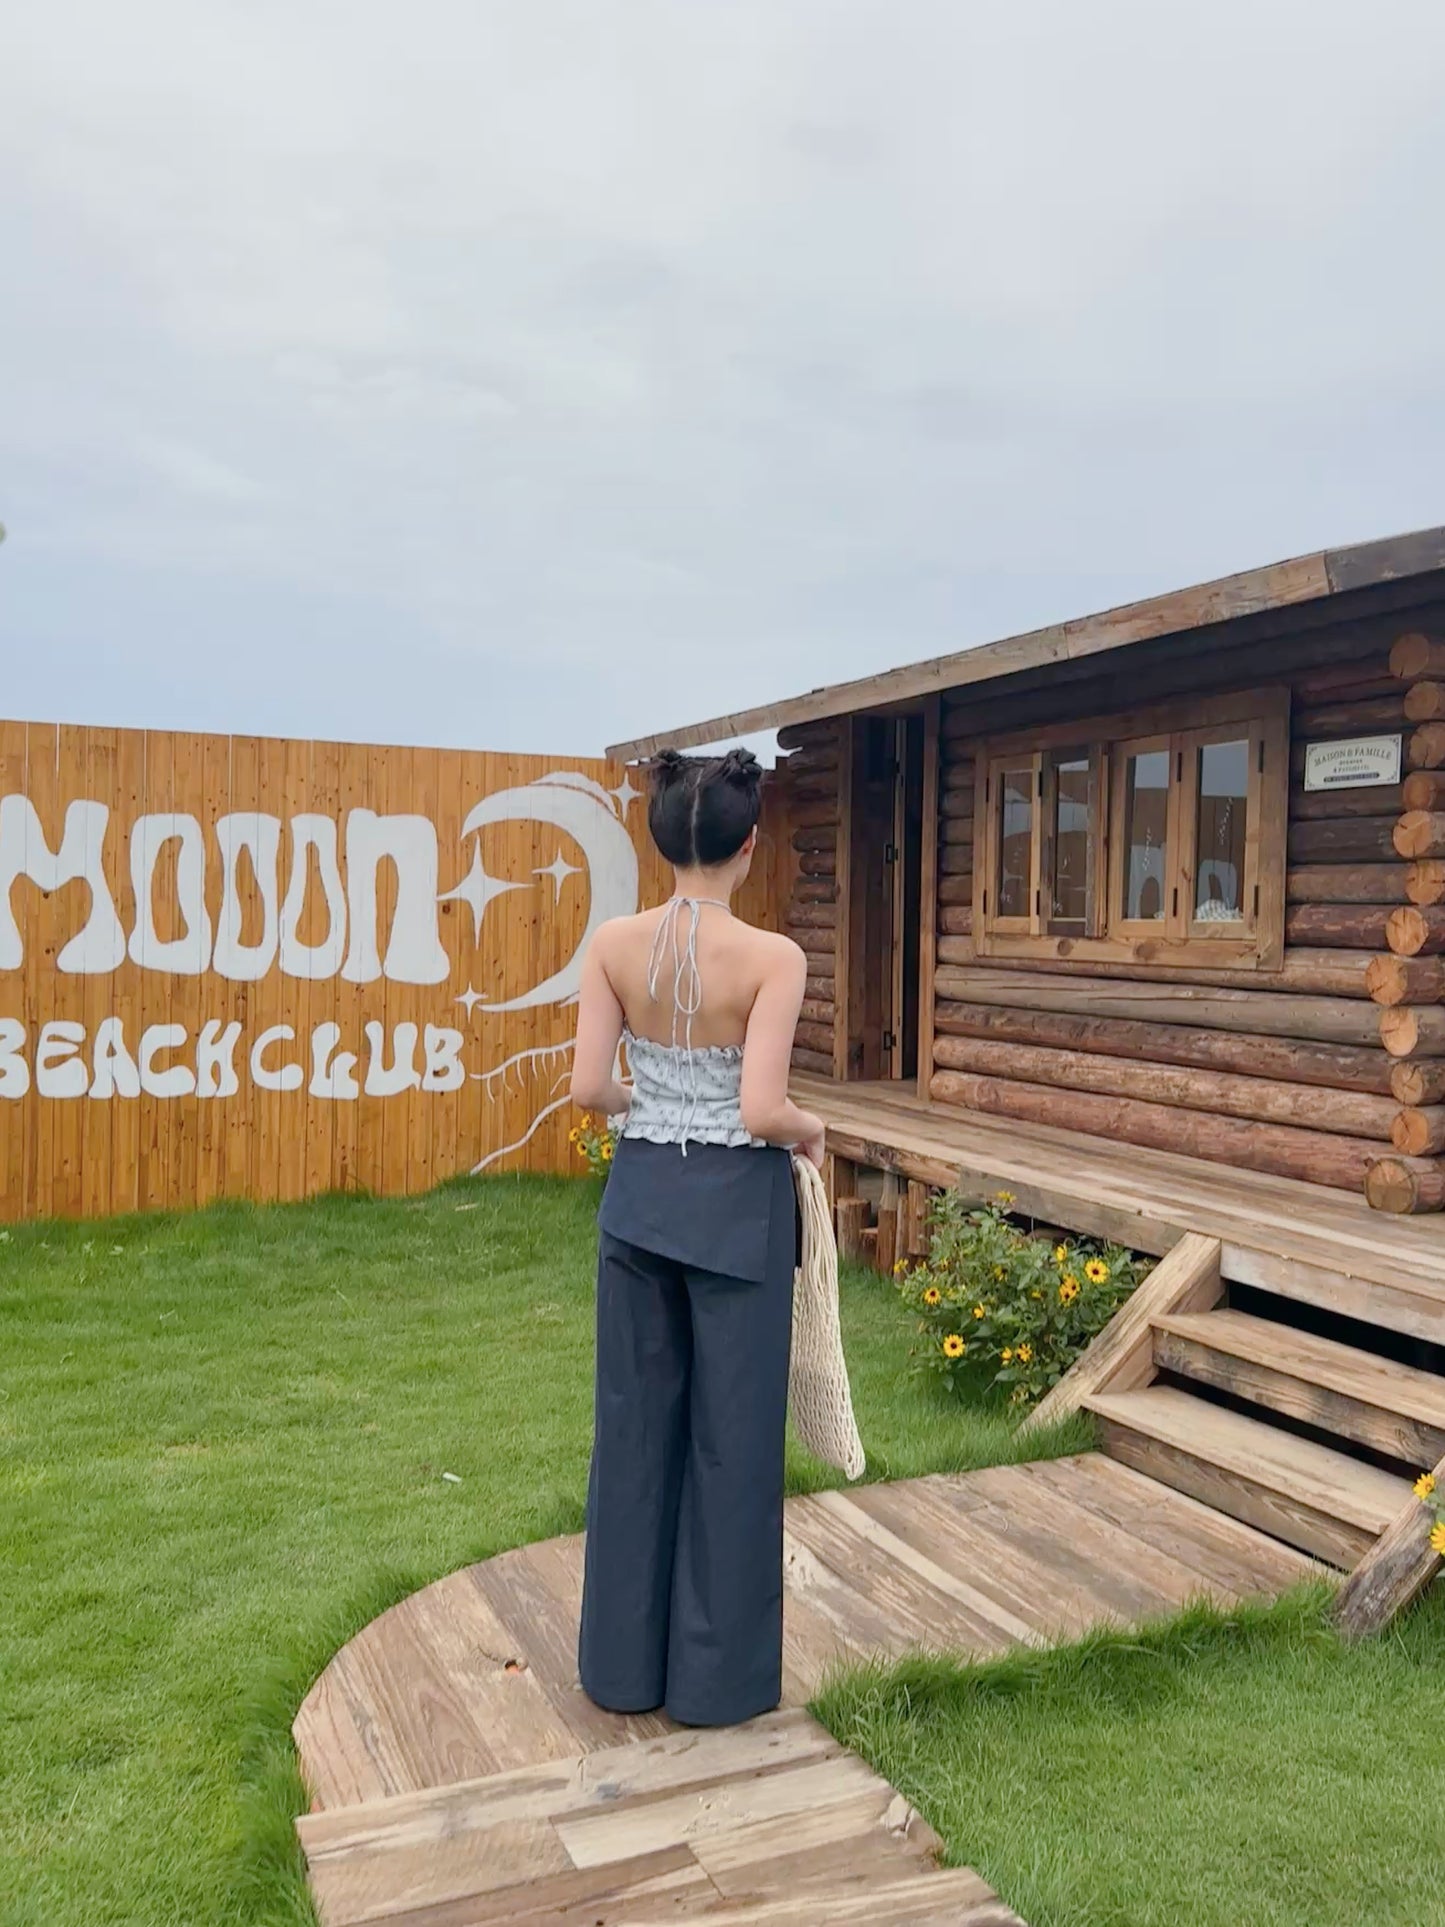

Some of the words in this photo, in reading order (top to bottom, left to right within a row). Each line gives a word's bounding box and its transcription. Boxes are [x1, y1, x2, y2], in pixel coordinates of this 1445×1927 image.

[1314, 749, 1346, 766] MAISON
[1354, 747, 1392, 760] FAMILLE
[250, 1020, 466, 1100] CLUB
